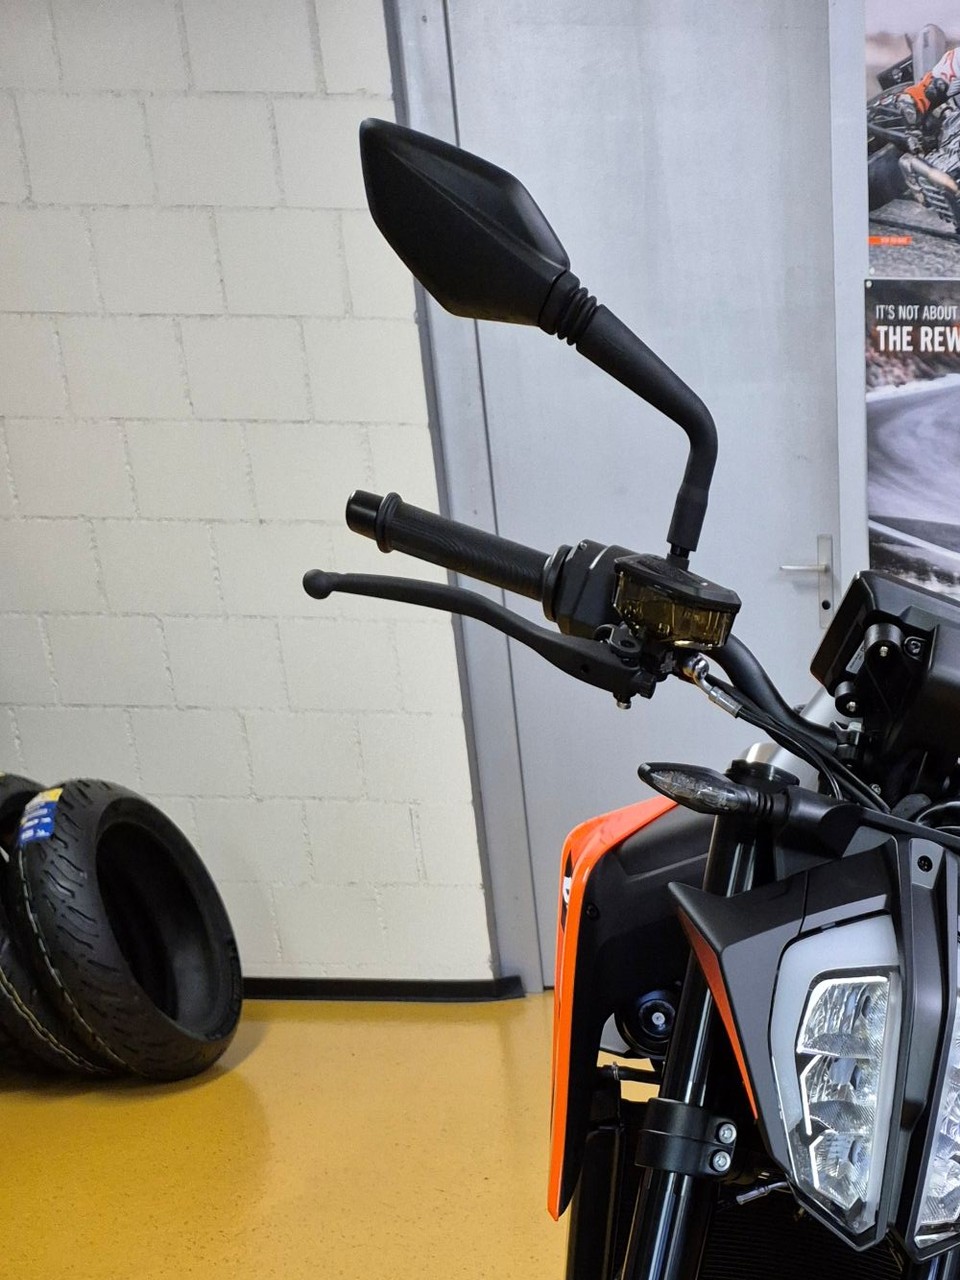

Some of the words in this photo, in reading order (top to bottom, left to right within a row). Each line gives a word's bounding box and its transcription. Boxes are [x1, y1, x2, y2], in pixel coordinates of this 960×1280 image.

[875, 304, 896, 320] IT'S
[898, 305, 919, 320] NOT
[922, 305, 958, 321] ABOUT
[876, 325, 914, 352] THE
